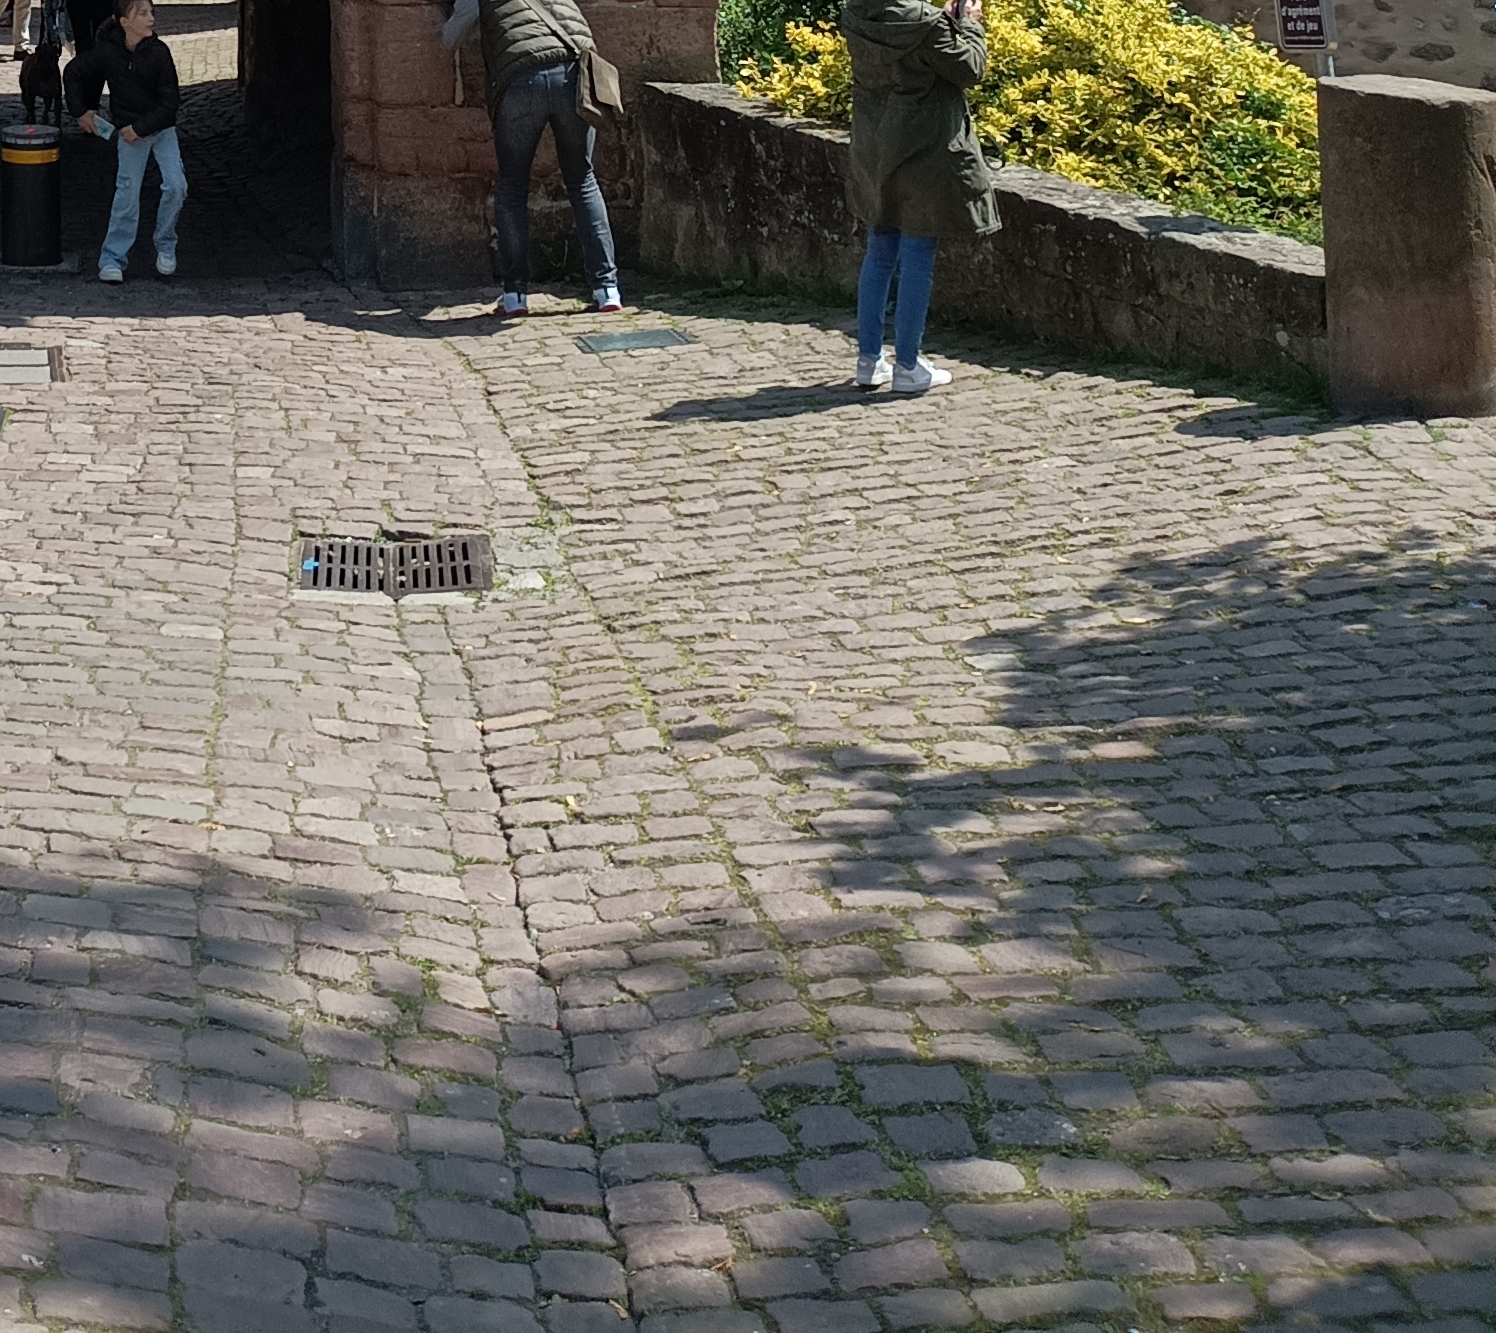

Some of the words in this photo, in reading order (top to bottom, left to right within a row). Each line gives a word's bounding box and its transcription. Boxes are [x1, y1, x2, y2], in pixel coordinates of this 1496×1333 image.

[1287, 21, 1295, 31] et
[1296, 20, 1305, 31] de
[1306, 20, 1318, 33] jeu
